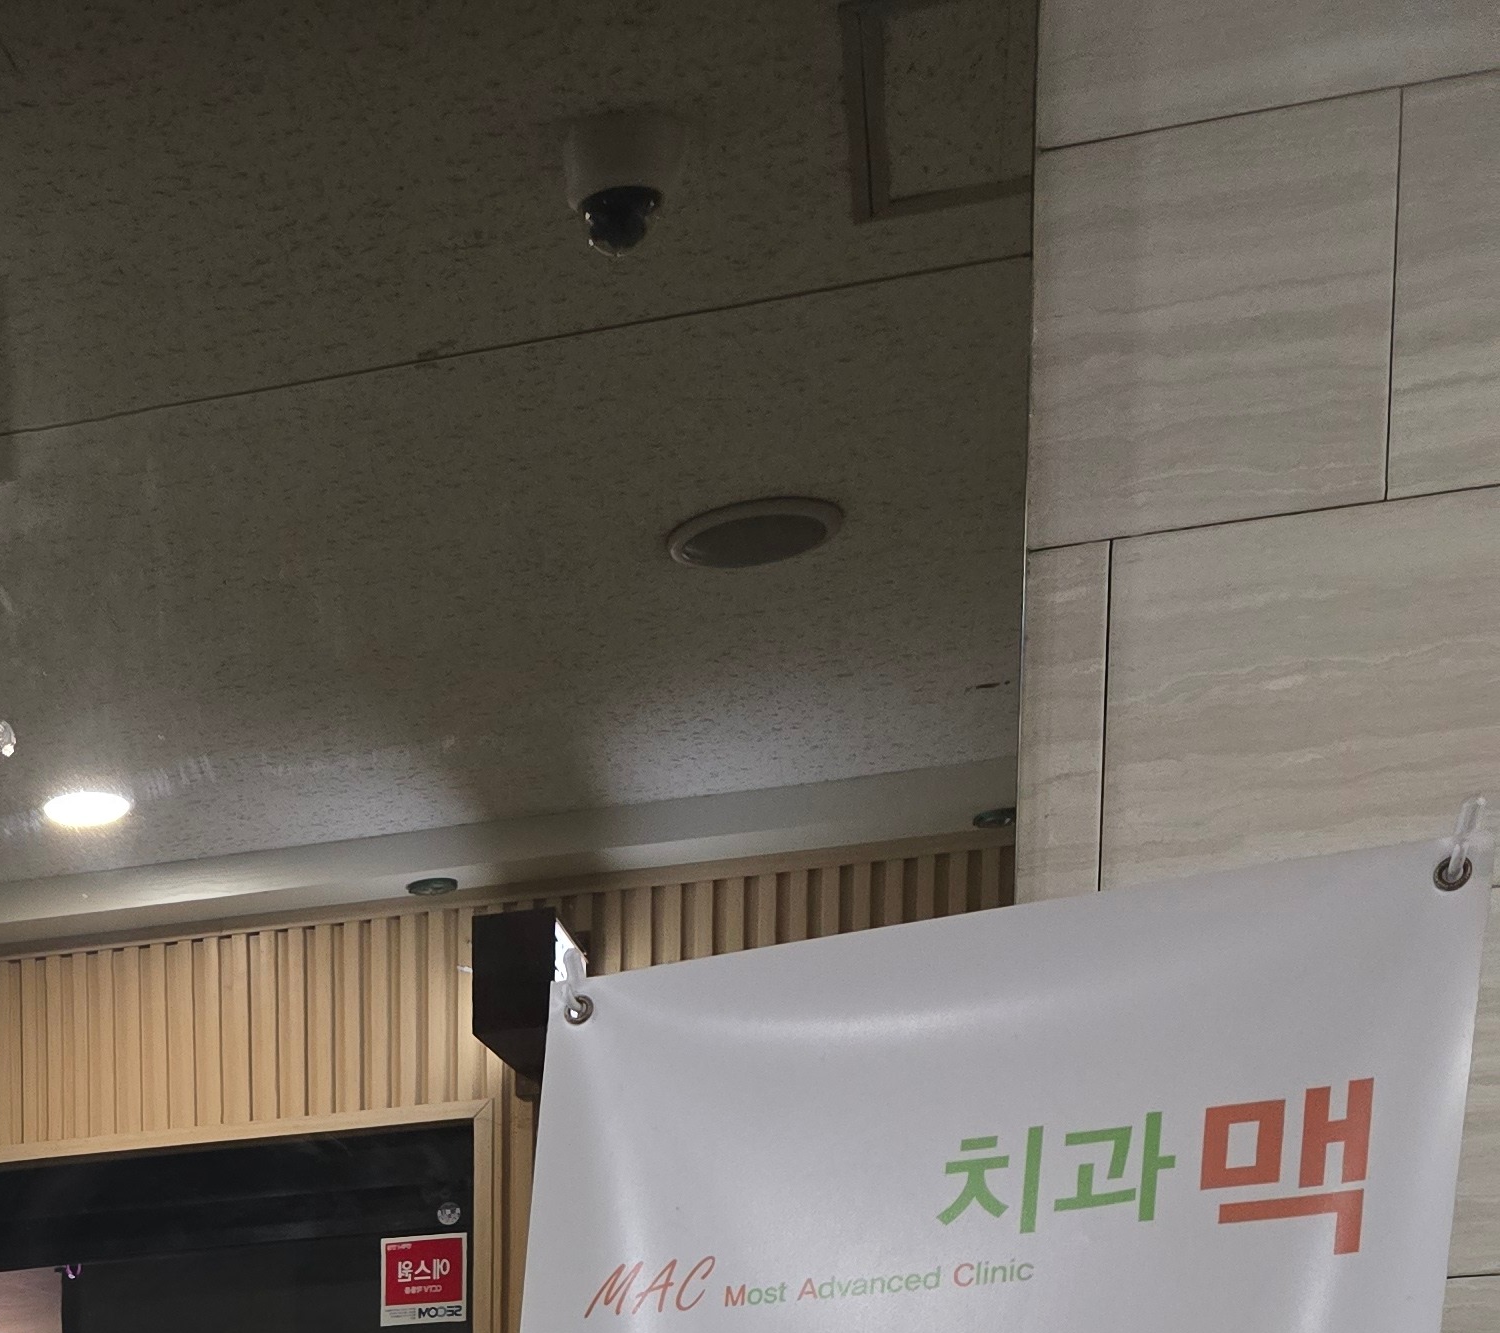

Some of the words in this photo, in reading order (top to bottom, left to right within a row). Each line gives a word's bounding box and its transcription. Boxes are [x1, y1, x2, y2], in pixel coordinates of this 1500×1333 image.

[937, 1077, 1375, 1256] 치과맥
[584, 1256, 716, 1319] MAC
[724, 1281, 788, 1307] Most
[797, 1267, 942, 1301] Advanced
[952, 1258, 1036, 1289] Clinic
